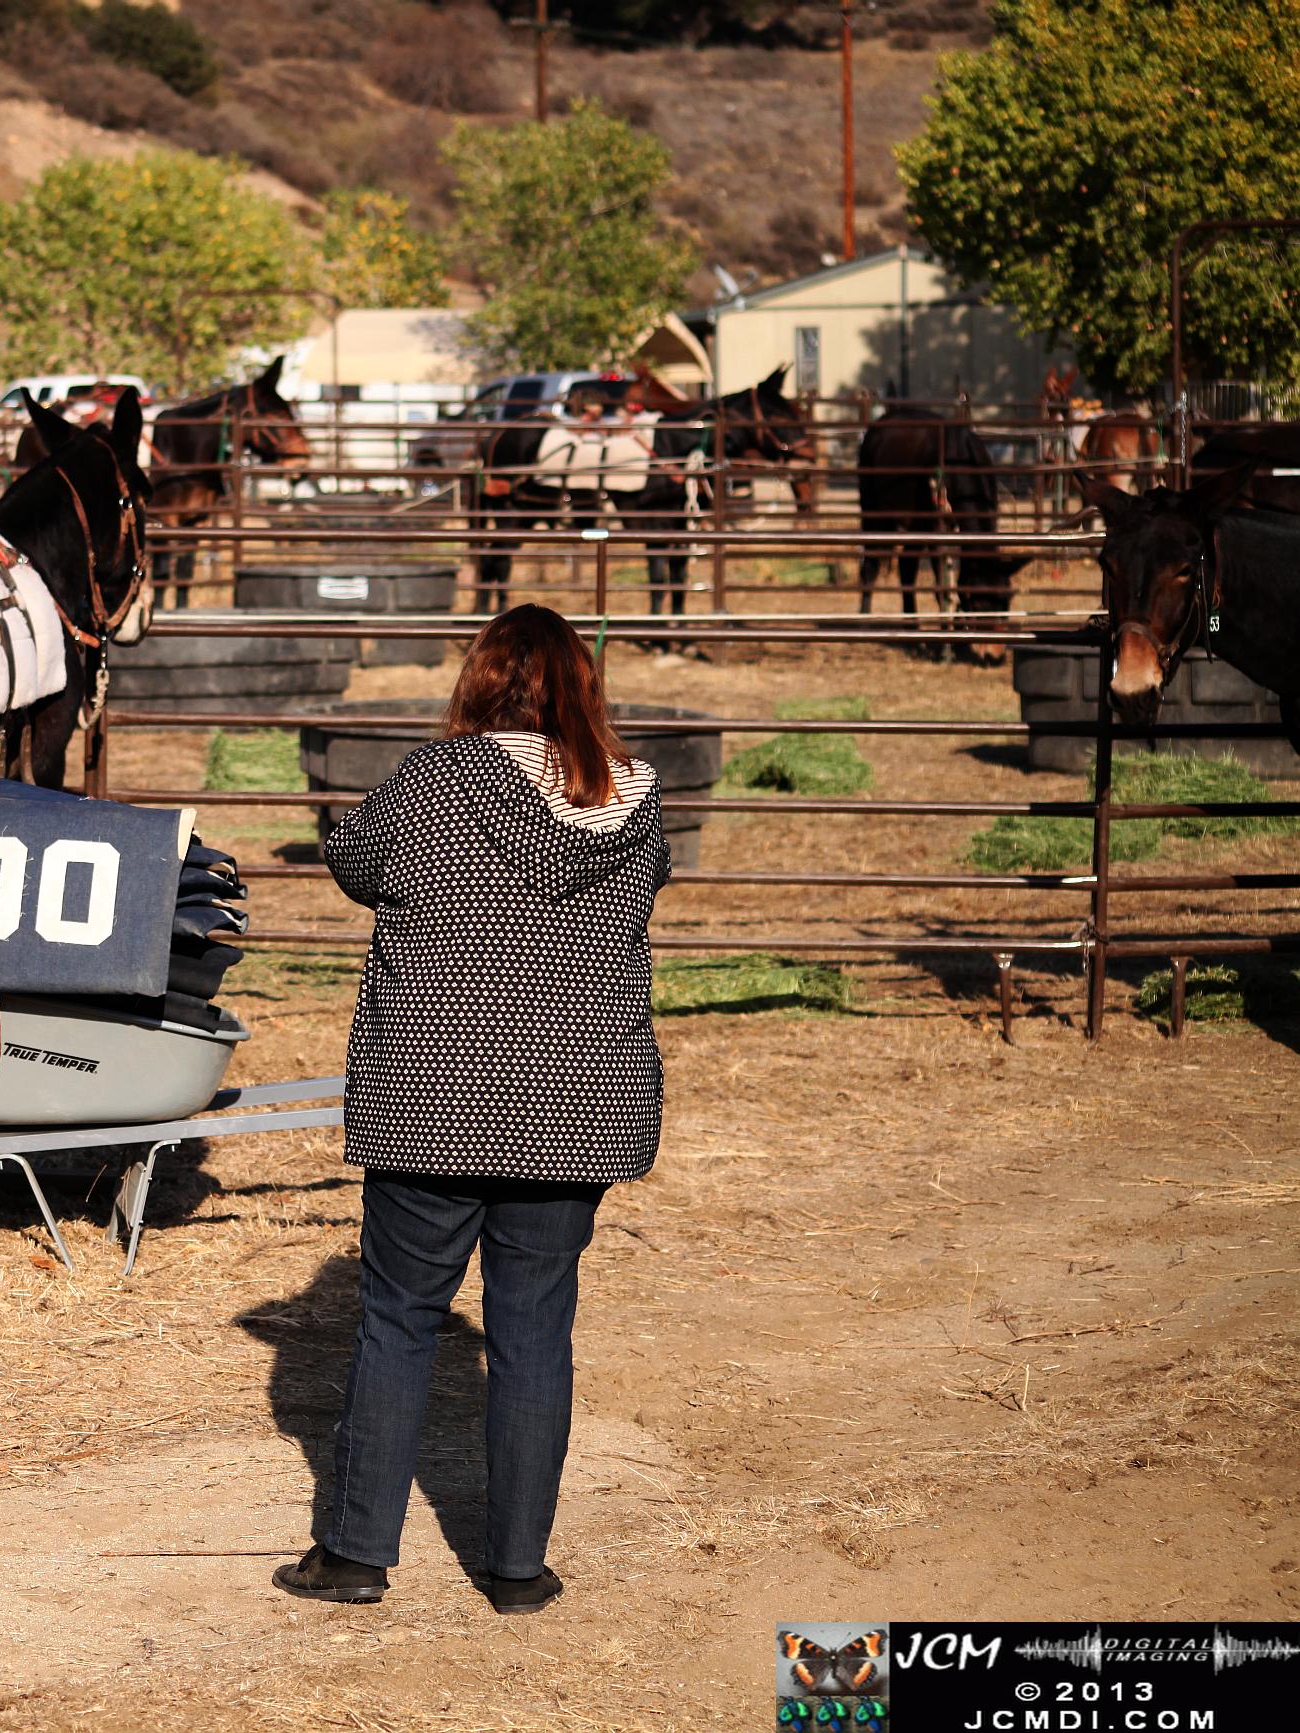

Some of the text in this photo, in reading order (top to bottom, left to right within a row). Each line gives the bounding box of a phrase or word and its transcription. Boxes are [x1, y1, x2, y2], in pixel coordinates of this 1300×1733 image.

[1209, 615, 1220, 632] 53
[3, 1042, 100, 1074] TRUE TEMPER
